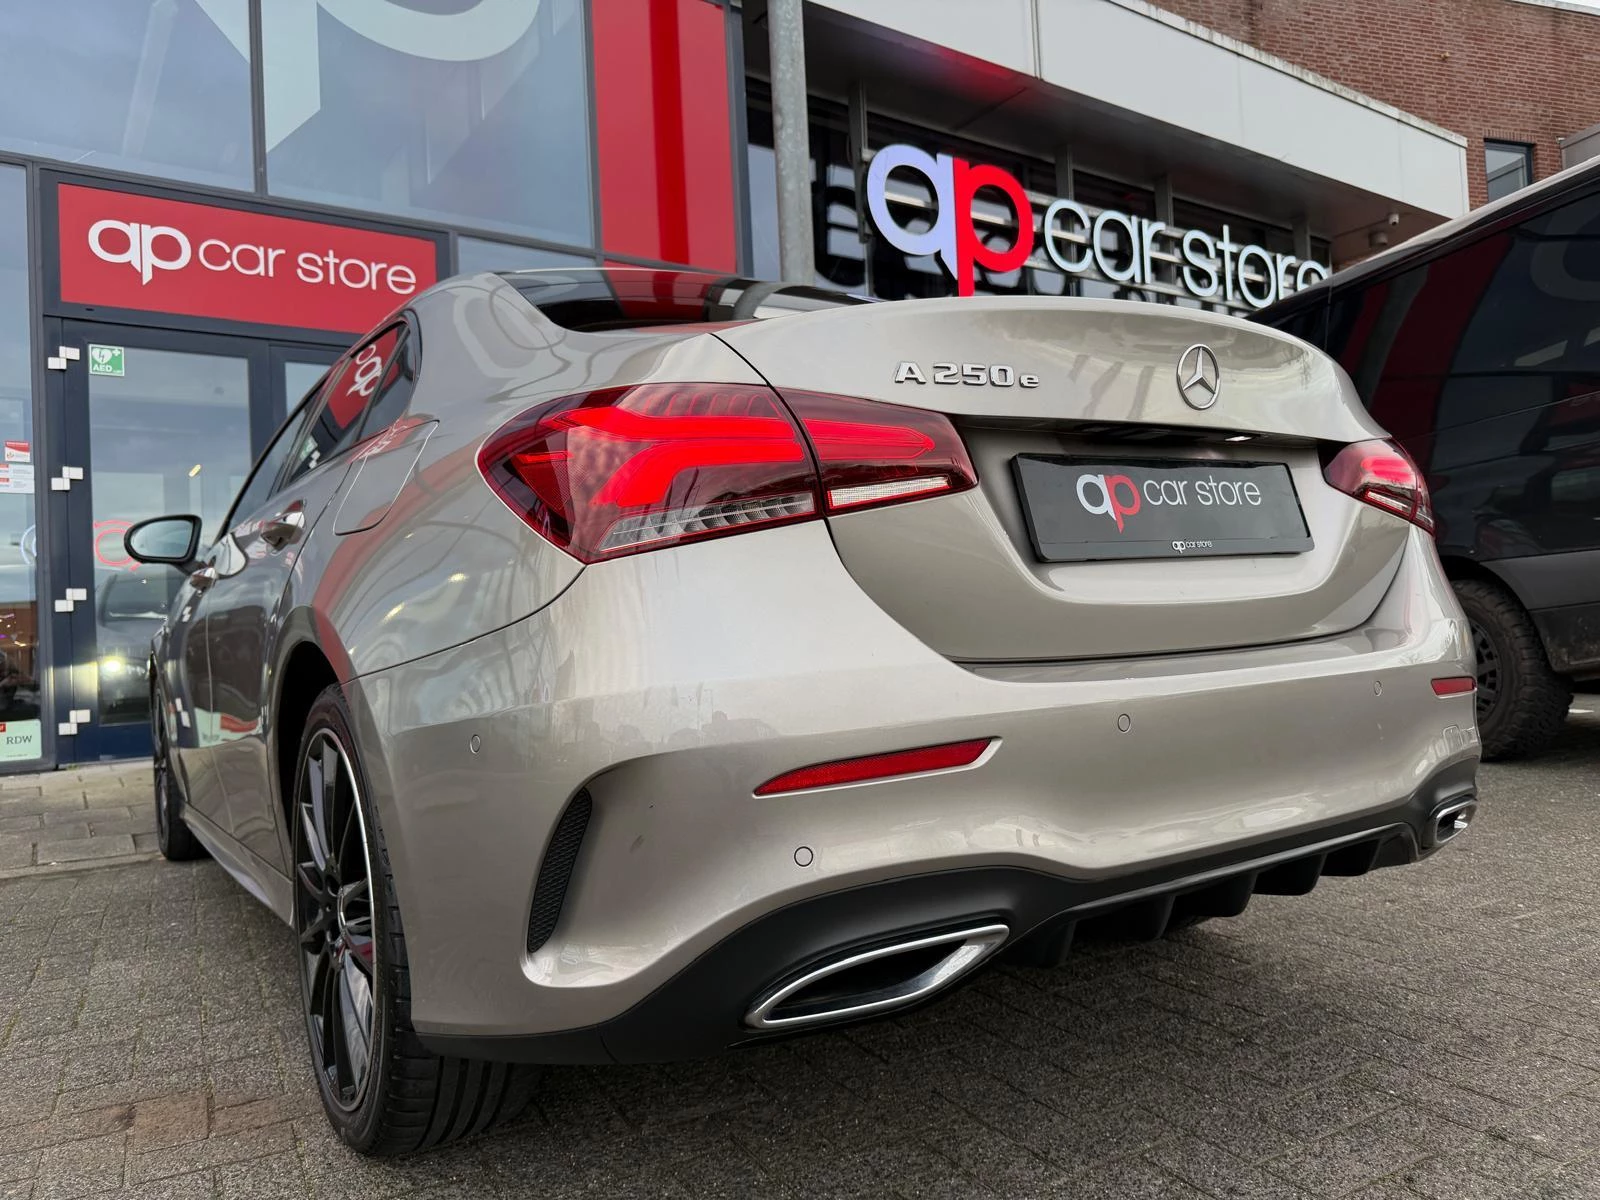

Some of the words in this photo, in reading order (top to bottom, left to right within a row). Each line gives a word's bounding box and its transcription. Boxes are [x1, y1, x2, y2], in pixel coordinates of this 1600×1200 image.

[866, 144, 1034, 298] ap
[1044, 199, 1166, 285] car
[88, 219, 192, 286] ap
[199, 239, 285, 277] car
[297, 249, 417, 295] store
[93, 364, 113, 372] AED
[1076, 474, 1142, 534] ap
[1143, 479, 1188, 506] car
[1195, 475, 1261, 506] store
[6, 735, 32, 745] RDW
